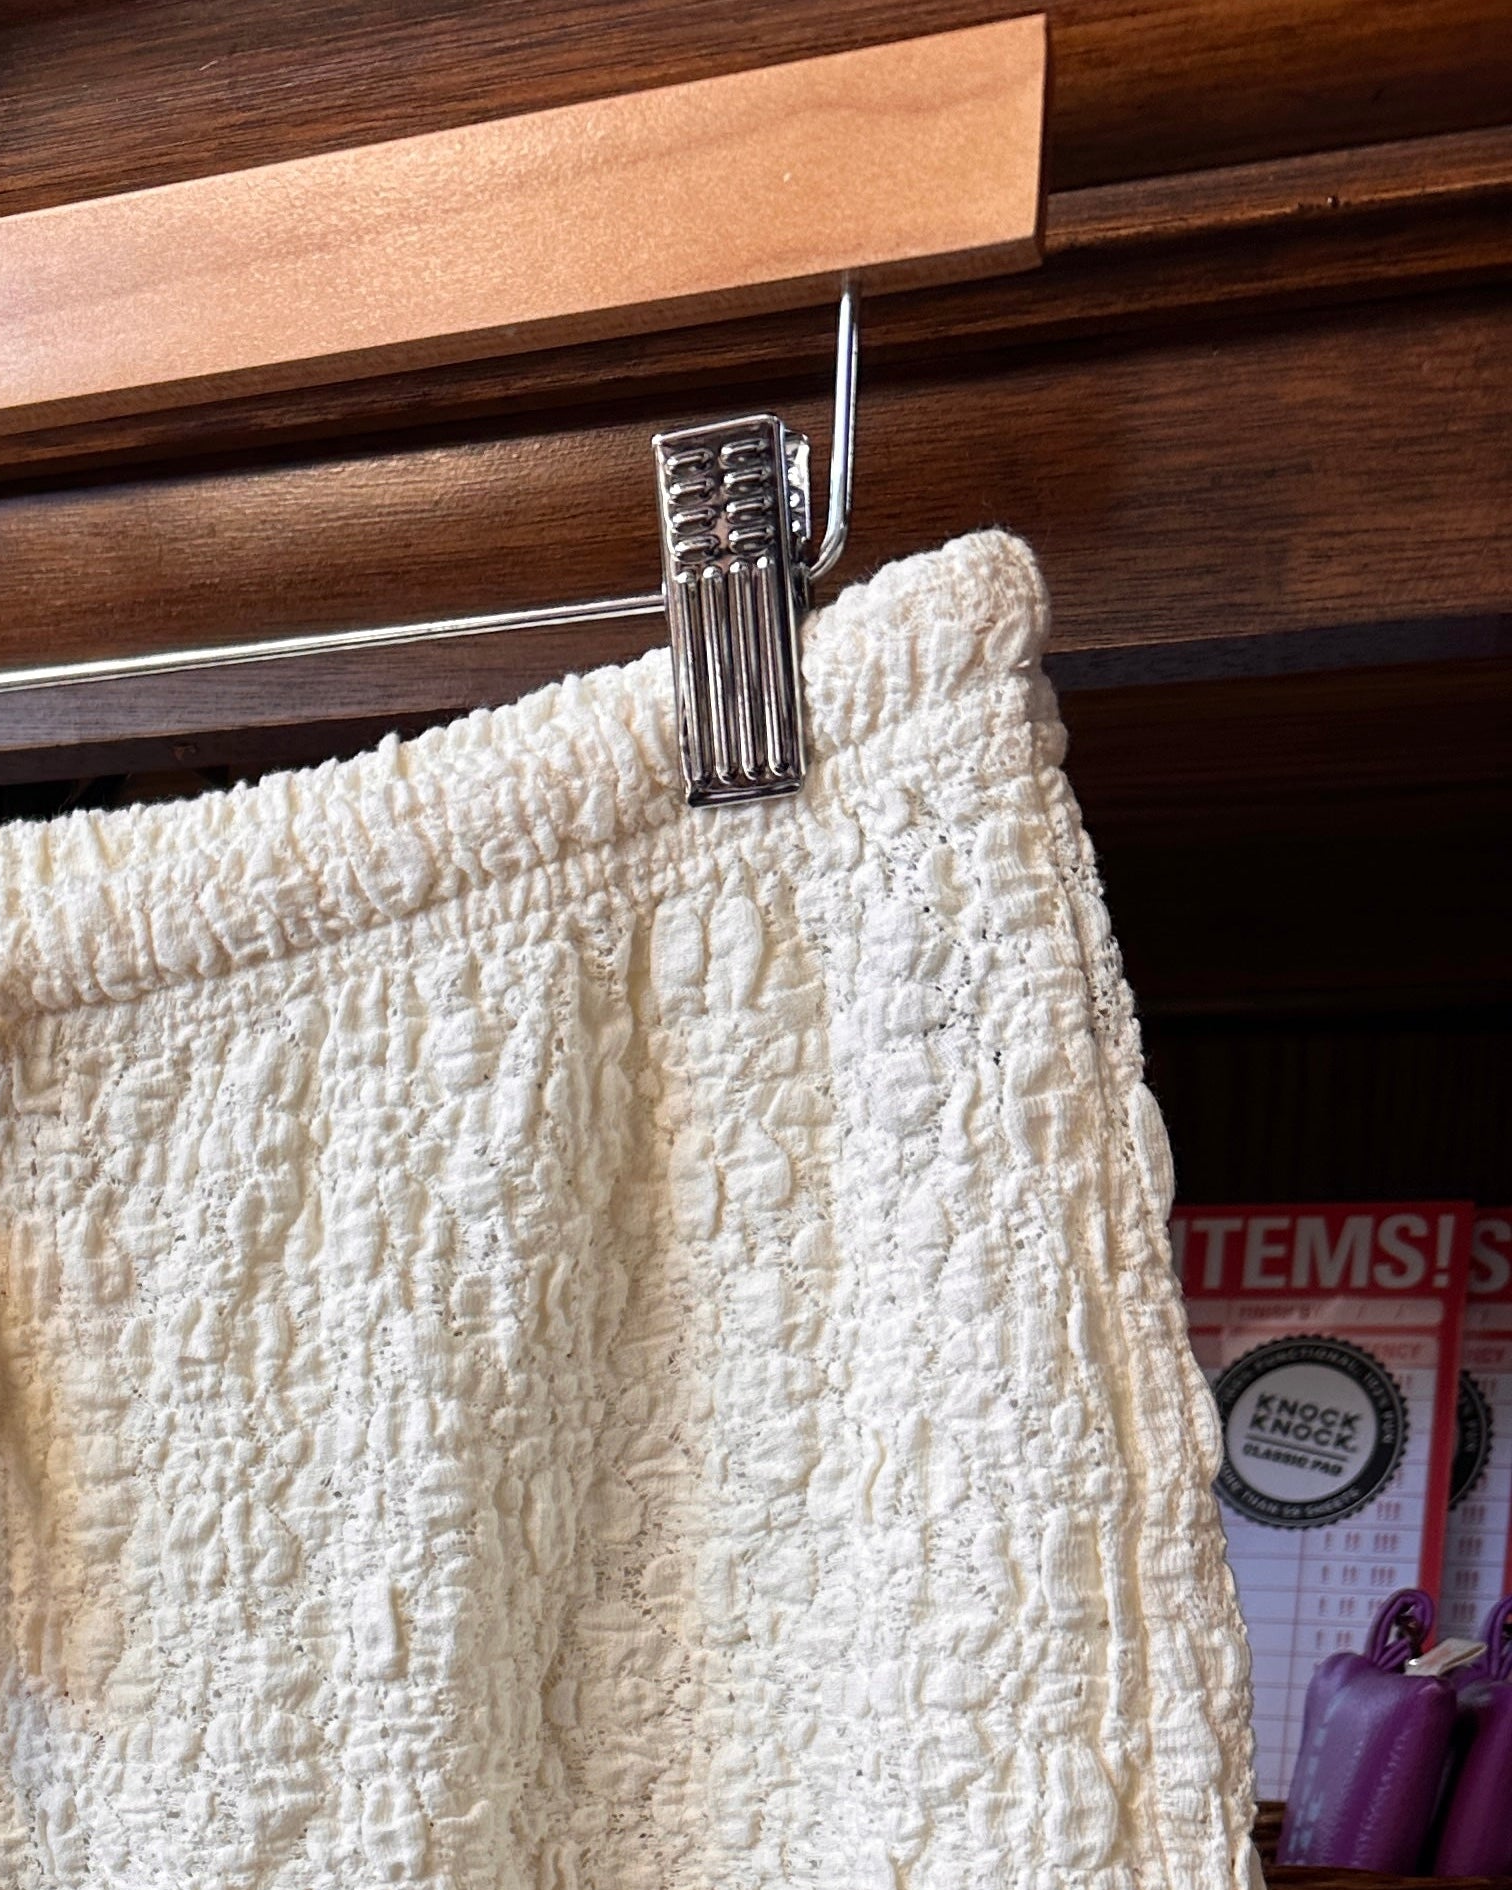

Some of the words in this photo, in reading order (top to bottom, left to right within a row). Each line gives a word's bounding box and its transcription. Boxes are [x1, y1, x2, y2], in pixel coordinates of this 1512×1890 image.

[1171, 1212, 1456, 1291] ITEMS!
[1247, 1413, 1355, 1450] KNOCK
[1256, 1392, 1364, 1433] KNOCK
[1242, 1442, 1308, 1471] CLASSIC
[1309, 1457, 1345, 1478] PAD
